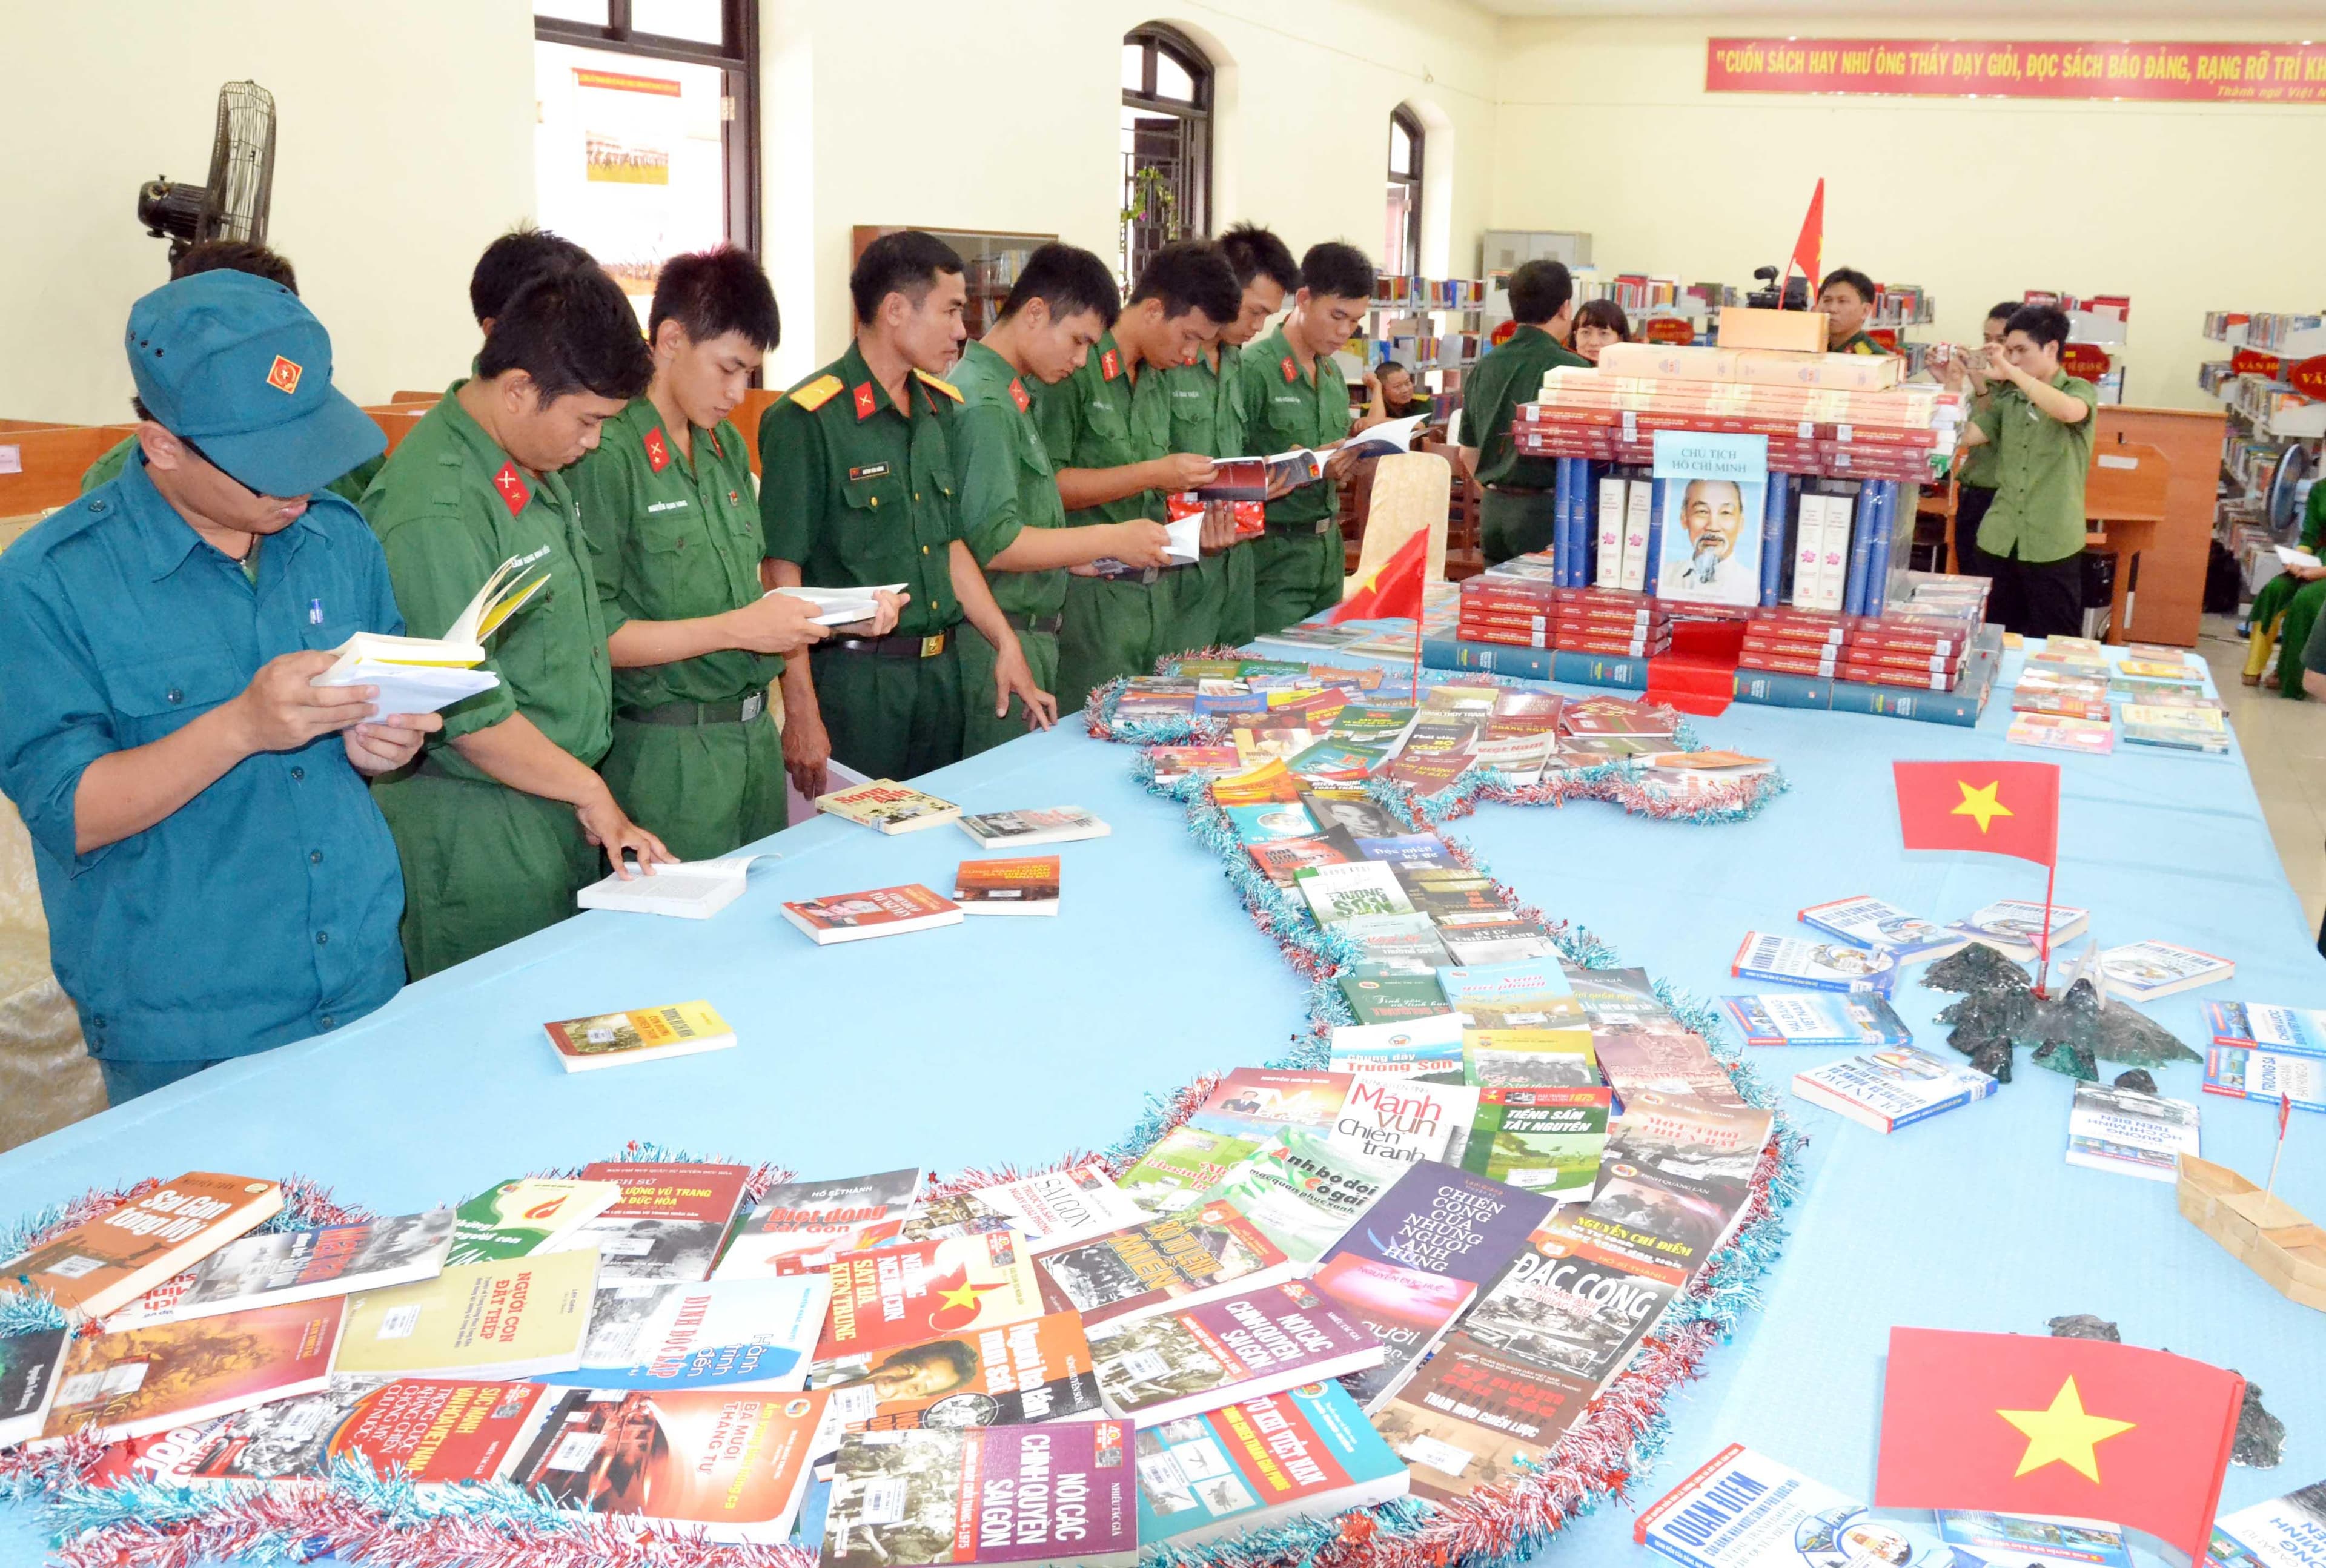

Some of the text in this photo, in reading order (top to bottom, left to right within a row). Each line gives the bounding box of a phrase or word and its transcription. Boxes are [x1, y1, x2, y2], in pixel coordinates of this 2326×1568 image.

[1717, 42, 1764, 73] "CUỐN
[1767, 45, 1804, 73] SÁCH
[1809, 51, 1836, 74] HAY
[1841, 48, 1873, 74] NHƯ
[1875, 46, 1905, 76] ÔNG
[1909, 44, 1949, 76] THẦY
[1952, 53, 1983, 81] DẠY
[1987, 44, 2021, 81] GIỎI,
[2026, 53, 2058, 82] ĐỌC
[2062, 47, 2103, 78] SÁCH
[2107, 47, 2141, 79] BÁO
[2144, 46, 2192, 84] ĐẢNG,
[2196, 55, 2241, 84] RẠNG
[2244, 50, 2271, 80] RỠ
[2274, 50, 2303, 81] TRÍ
[1672, 459, 1746, 472] HỒ CHÍ MINH
[1681, 446, 1737, 460] CHỦ TỊCH
[874, 787, 913, 804] Anh
[1569, 1093, 1595, 1102] 1975
[1503, 1119, 1592, 1132] TÂY NGUYÊN
[1507, 1108, 1548, 1119] TIẾNG
[1270, 1146, 1316, 1172] Anh
[1362, 1140, 1425, 1162] tranh
[628, 1196, 652, 1205] ĐỨC
[658, 1186, 675, 1196] VŨ
[676, 1188, 712, 1197] TRANG
[1438, 1185, 1506, 1214] CHIẾN
[1431, 1209, 1473, 1231] CỦA
[1433, 1197, 1492, 1223] CÔNG
[495, 1234, 522, 1243] con
[1575, 1216, 1629, 1241] NGUYỄN
[1629, 1232, 1658, 1246] CHÍ
[1400, 1240, 1451, 1261] ANH
[499, 1271, 532, 1343] NGƯỜI CON
[881, 1295, 906, 1322] CON
[1571, 1272, 1658, 1319] CÔNG
[686, 1345, 718, 1377] đến
[711, 1342, 744, 1377] trình
[736, 1333, 775, 1375] Hành
[383, 1384, 419, 1423] CHỐNG
[420, 1387, 454, 1421] TRONG
[473, 1386, 501, 1406] SỨC
[1423, 1391, 1456, 1412] THAM
[353, 1384, 403, 1443] CỨU NƯỚC
[740, 1401, 760, 1422] BA
[1251, 1409, 1296, 1435] KHÍ
[696, 1401, 739, 1475] THÁNG TƯ
[1267, 1429, 1309, 1460] VIỆT
[1284, 1456, 1328, 1486] NAM
[1016, 1434, 1053, 1545] CHÍNH QUYỀN
[980, 1478, 1017, 1547] SÀI GÒN
[1054, 1472, 1090, 1541] NỘI CÁC
[1662, 1499, 1732, 1547] QUAN
[1704, 1470, 1769, 1514] ĐIỂM
[2269, 1517, 2325, 1554] MINH
